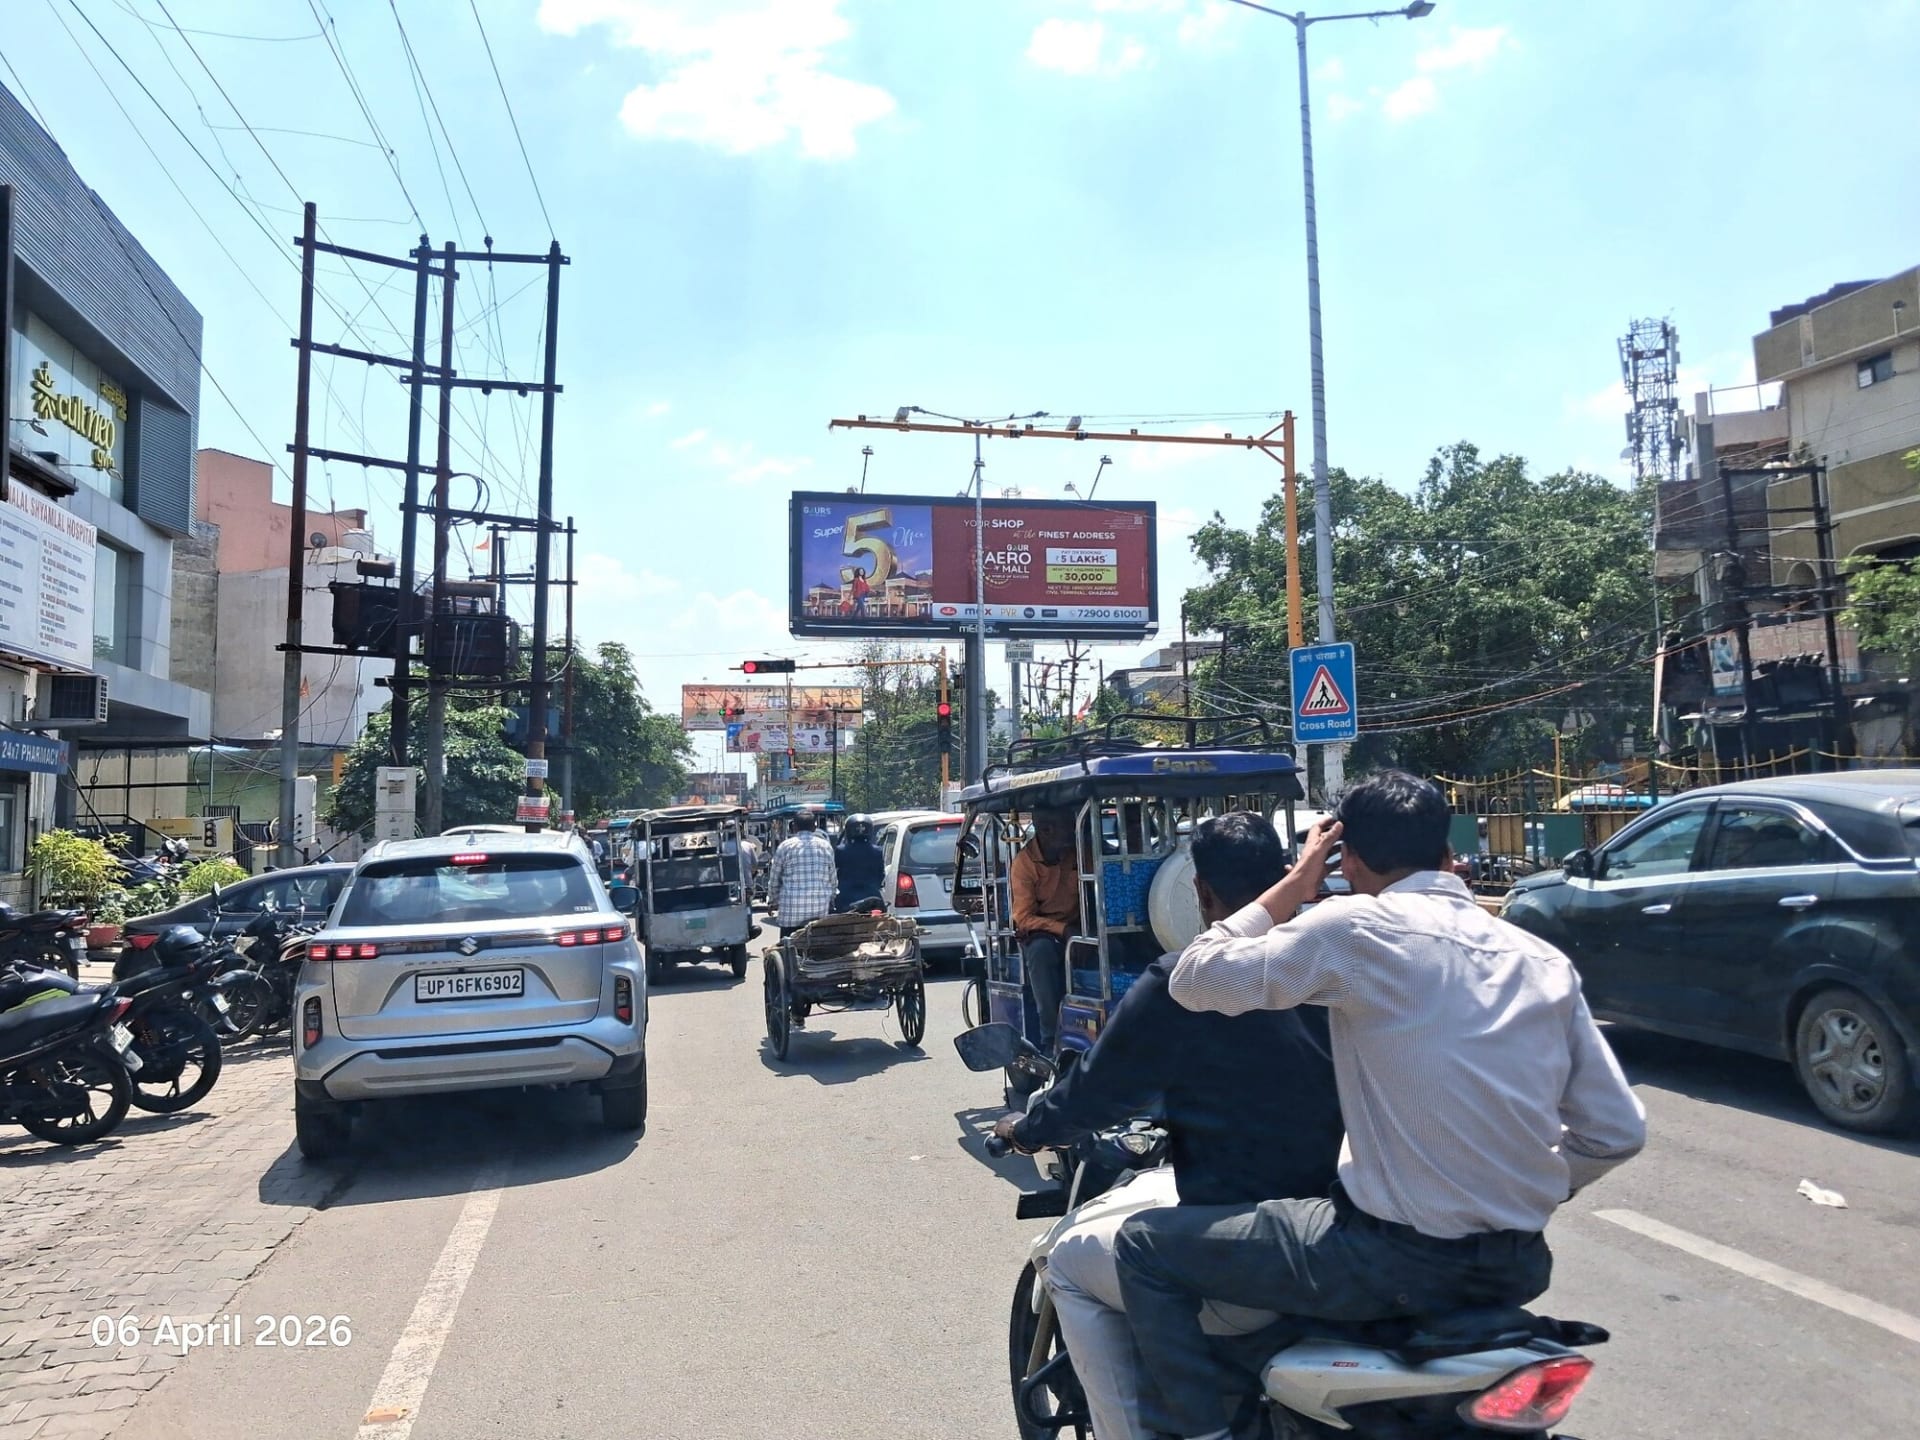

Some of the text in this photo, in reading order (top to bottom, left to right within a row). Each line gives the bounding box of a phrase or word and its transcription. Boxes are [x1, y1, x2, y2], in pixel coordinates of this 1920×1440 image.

[31, 496, 65, 533] SHYAMLAL
[66, 516, 95, 549] HOSPITAL
[991, 519, 1024, 529] SHOP
[1038, 530, 1070, 540] FINEST
[1072, 531, 1116, 540] ADDRESS
[813, 525, 844, 539] Super
[840, 507, 898, 588] 5
[984, 551, 1032, 565] AERO
[1002, 565, 1030, 574] MALL
[1001, 607, 1017, 617] PVR
[1077, 608, 1110, 618] 72900
[1113, 609, 1142, 618] 61001
[1299, 718, 1351, 731] Cross Road
[21, 744, 59, 766] PHARMACY
[427, 975, 521, 995] UP16FK6902
